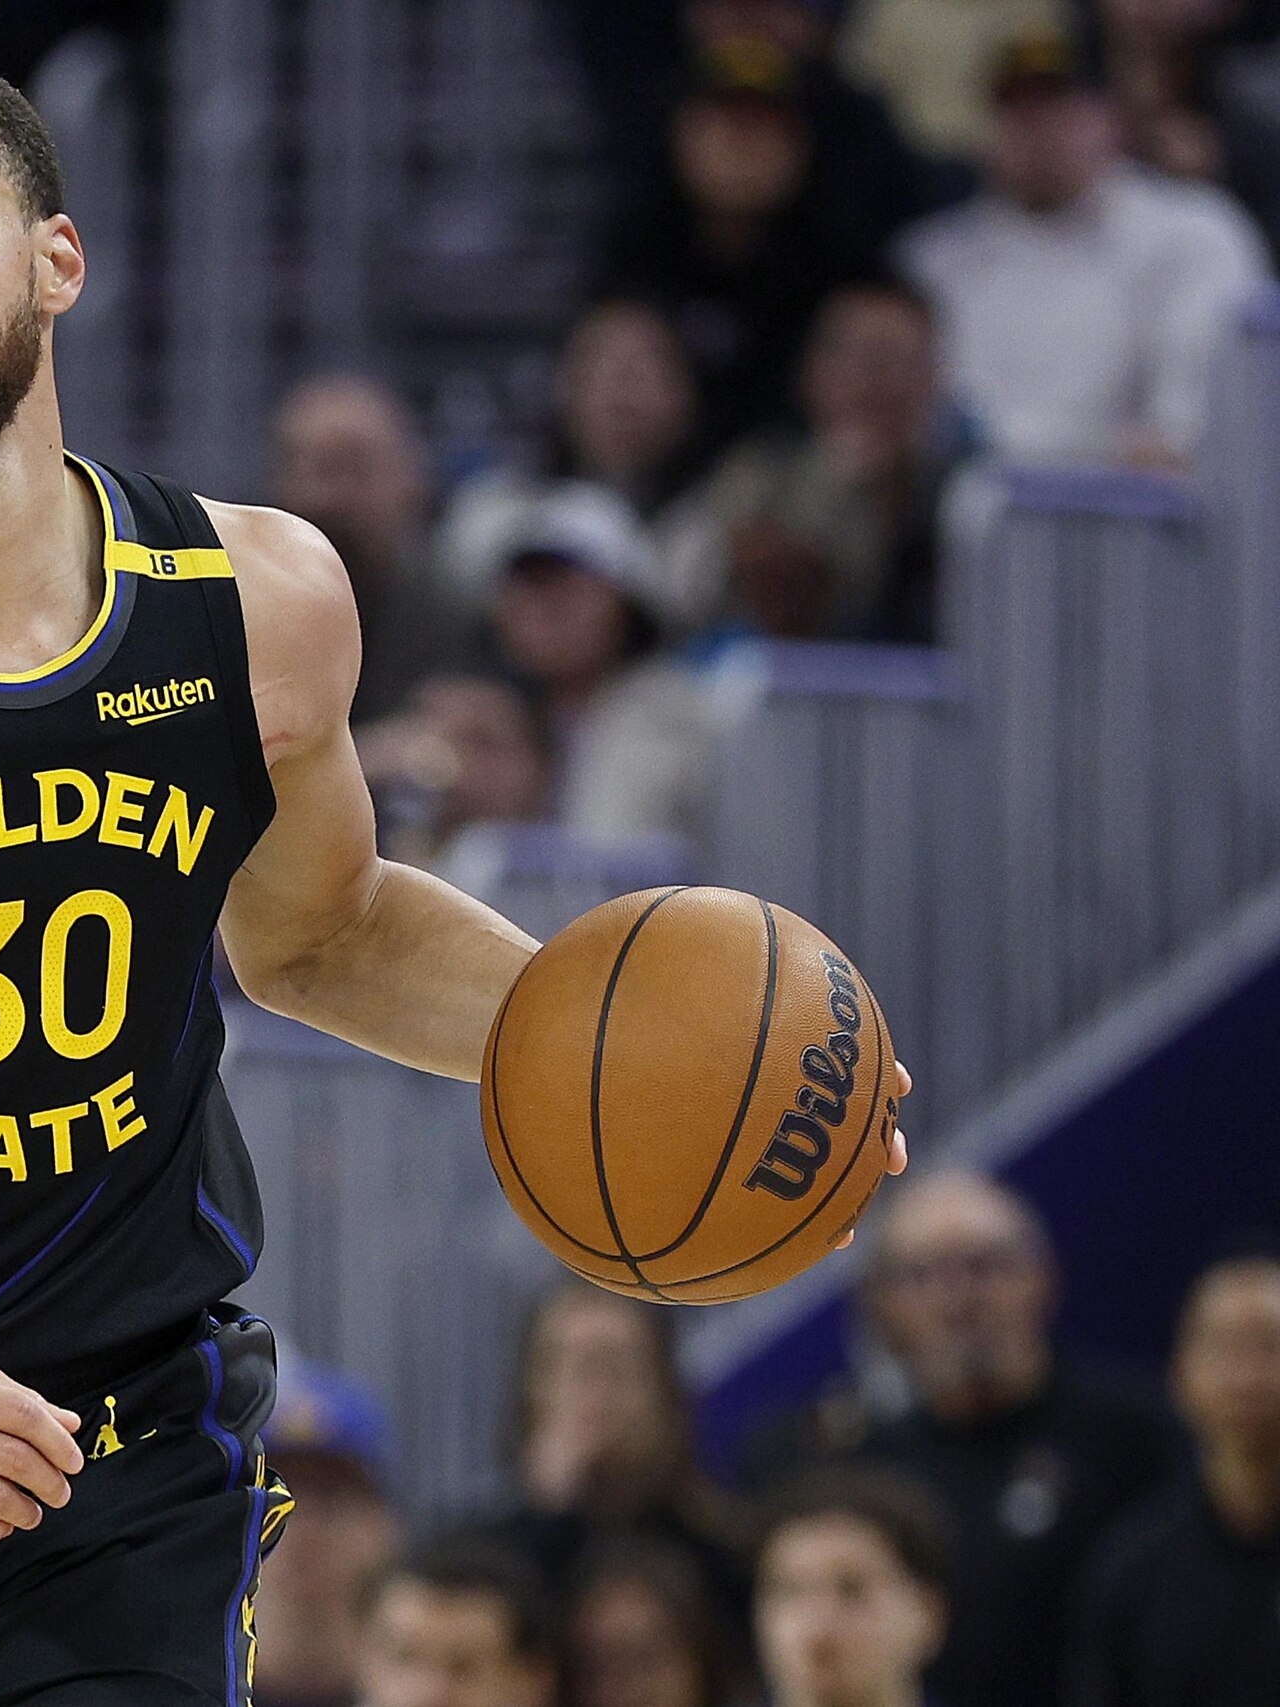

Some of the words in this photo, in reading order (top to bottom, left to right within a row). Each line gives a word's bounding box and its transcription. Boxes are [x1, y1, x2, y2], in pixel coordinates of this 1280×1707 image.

[149, 553, 177, 576] 16
[97, 674, 215, 724] Rakuten
[742, 950, 861, 1201] Wilson
